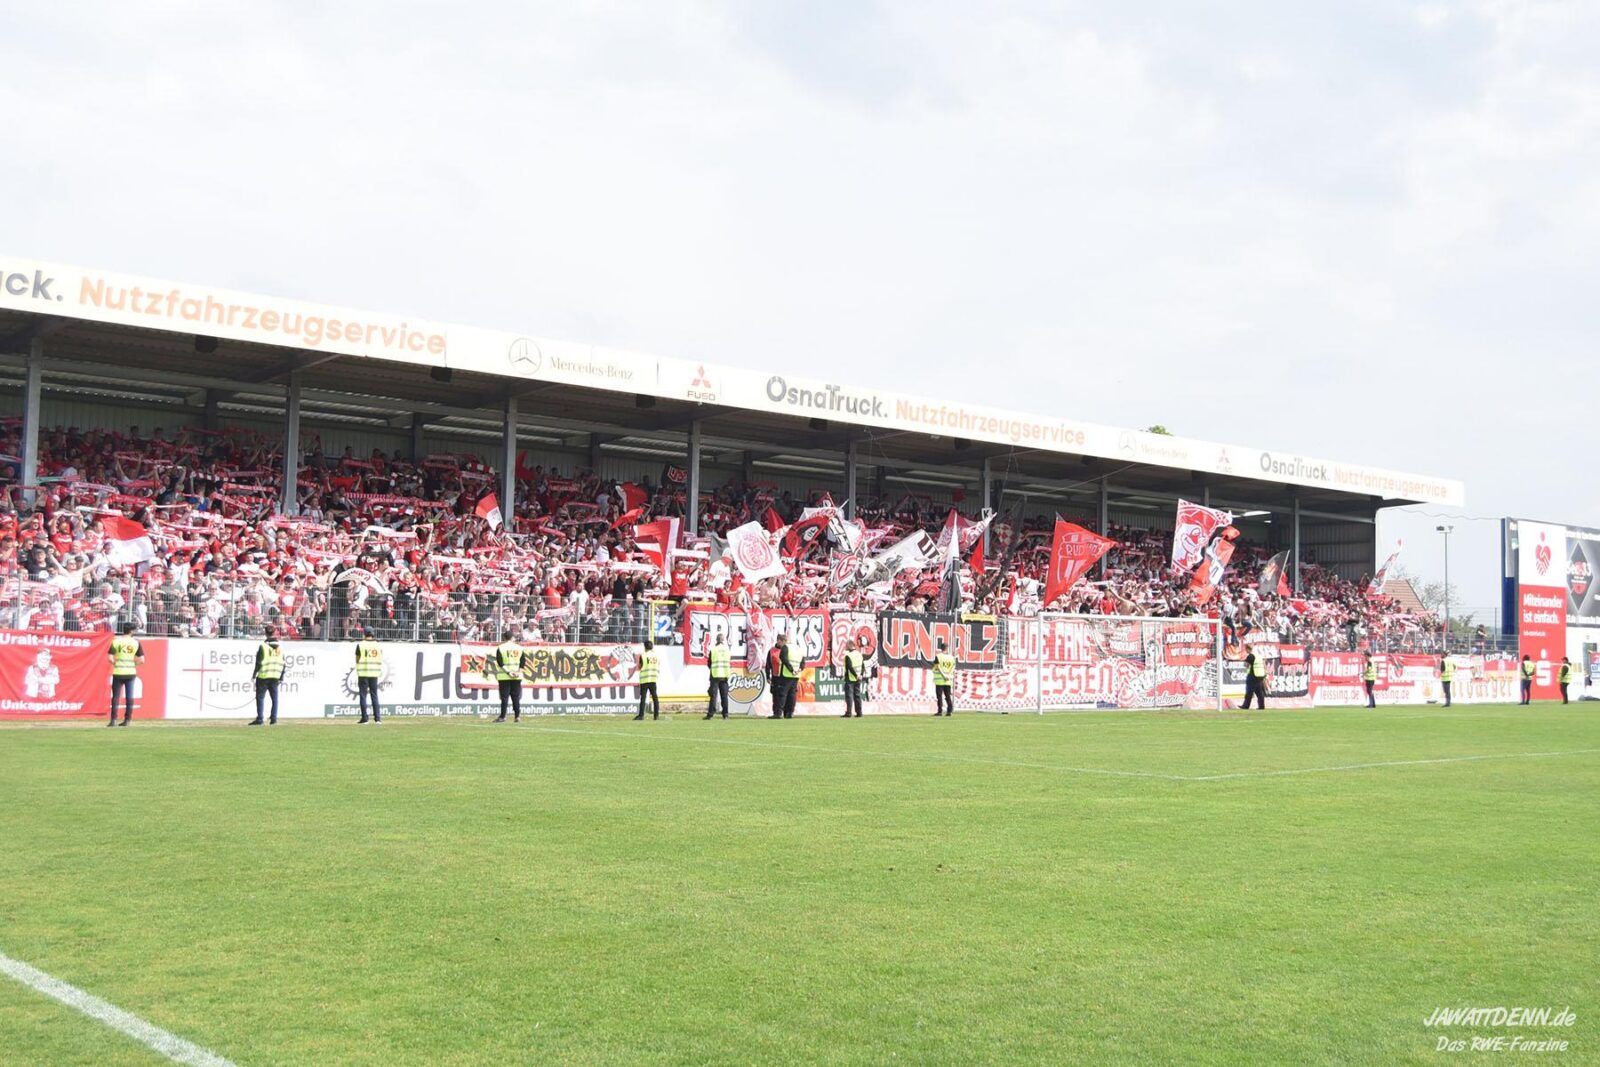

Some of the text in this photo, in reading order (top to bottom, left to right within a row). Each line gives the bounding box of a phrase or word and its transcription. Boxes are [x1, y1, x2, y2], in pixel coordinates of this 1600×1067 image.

[0, 269, 446, 355] ck. Nutzfahrzeugservice
[549, 355, 634, 381] Mercedes-Benz
[687, 390, 716, 402] FUSO
[766, 375, 1086, 445] OsnaTruck. Nutzfahrzeugservice
[1259, 452, 1447, 499] OsnaTruck. Nutzfahrzeugservice
[1523, 593, 1562, 608] Miteinander
[1523, 609, 1533, 623] ist
[690, 611, 823, 659] FREKS
[210, 650, 316, 668] Bestagen
[364, 649, 378, 658] K9
[209, 678, 299, 693] Lienenn
[1, 700, 84, 712] Unkaputtbar
[395, 705, 442, 717] Recycling,
[447, 705, 474, 715] Landt.
